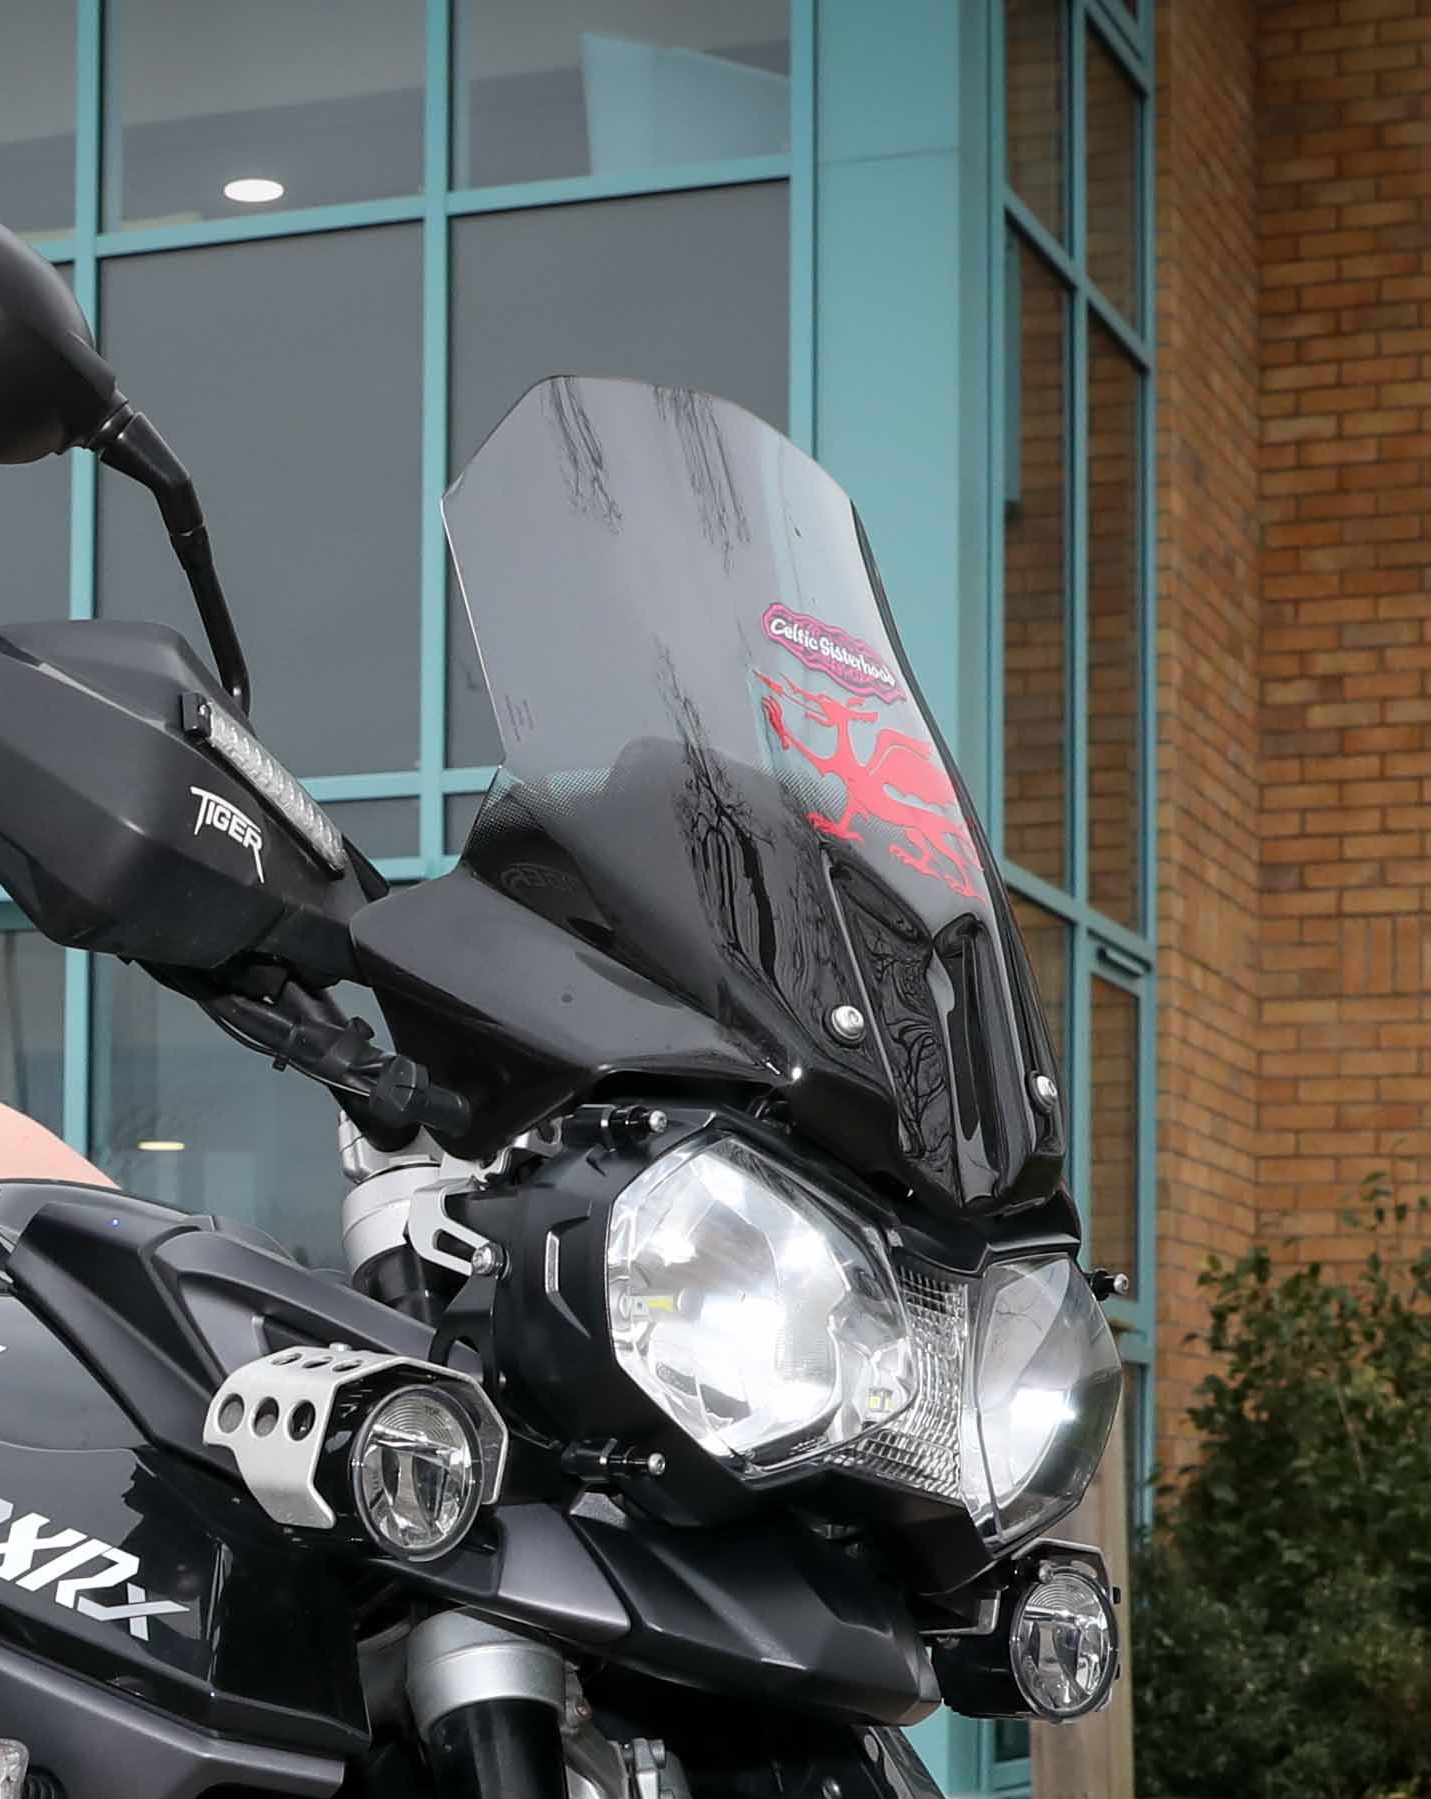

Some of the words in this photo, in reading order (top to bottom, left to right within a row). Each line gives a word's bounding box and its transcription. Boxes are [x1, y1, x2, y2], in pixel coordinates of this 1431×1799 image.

[770, 618, 819, 650] Celtic
[819, 637, 896, 686] Sisterhood
[190, 786, 265, 884] TIGER
